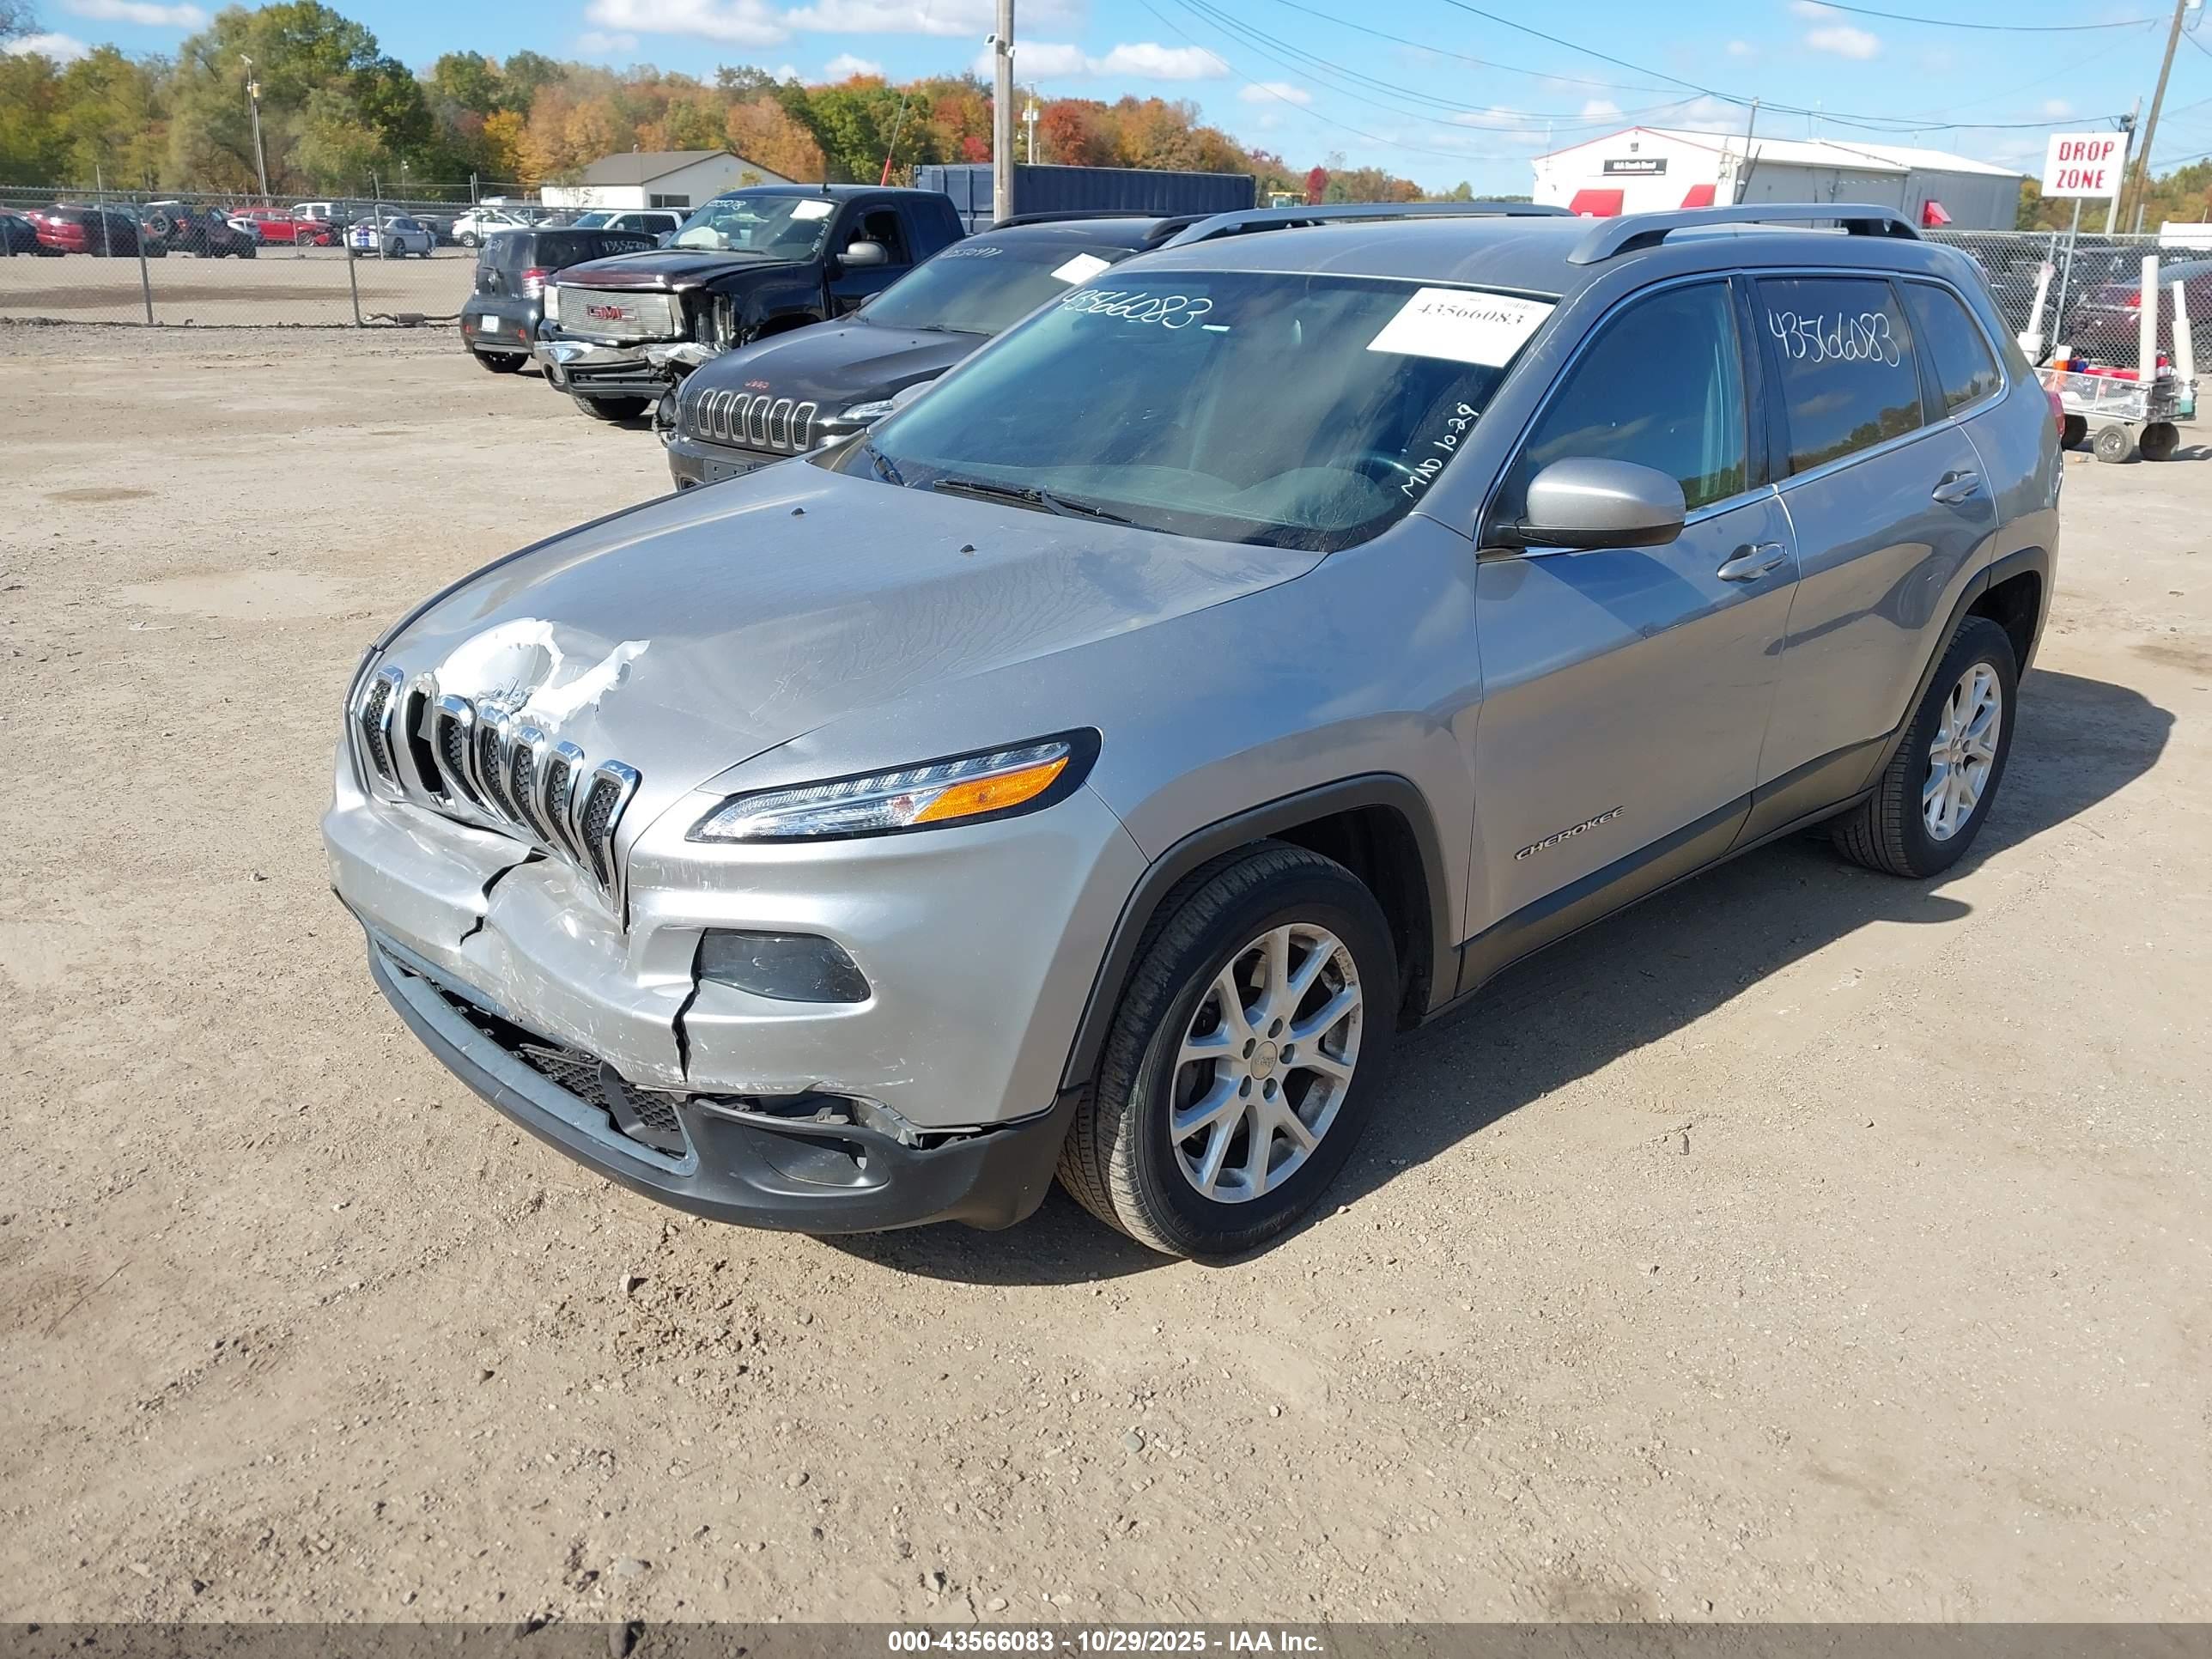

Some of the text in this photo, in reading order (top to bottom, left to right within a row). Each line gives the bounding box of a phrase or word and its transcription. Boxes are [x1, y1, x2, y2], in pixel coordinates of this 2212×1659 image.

[2058, 141, 2115, 161] DROP
[2056, 169, 2106, 189] ZONE
[586, 305, 636, 321] GMC
[1062, 289, 1212, 329] 43566083
[1417, 303, 1524, 325] 43566083
[1768, 308, 1900, 368] 43566083
[1514, 805, 1625, 860] CHEROKEE
